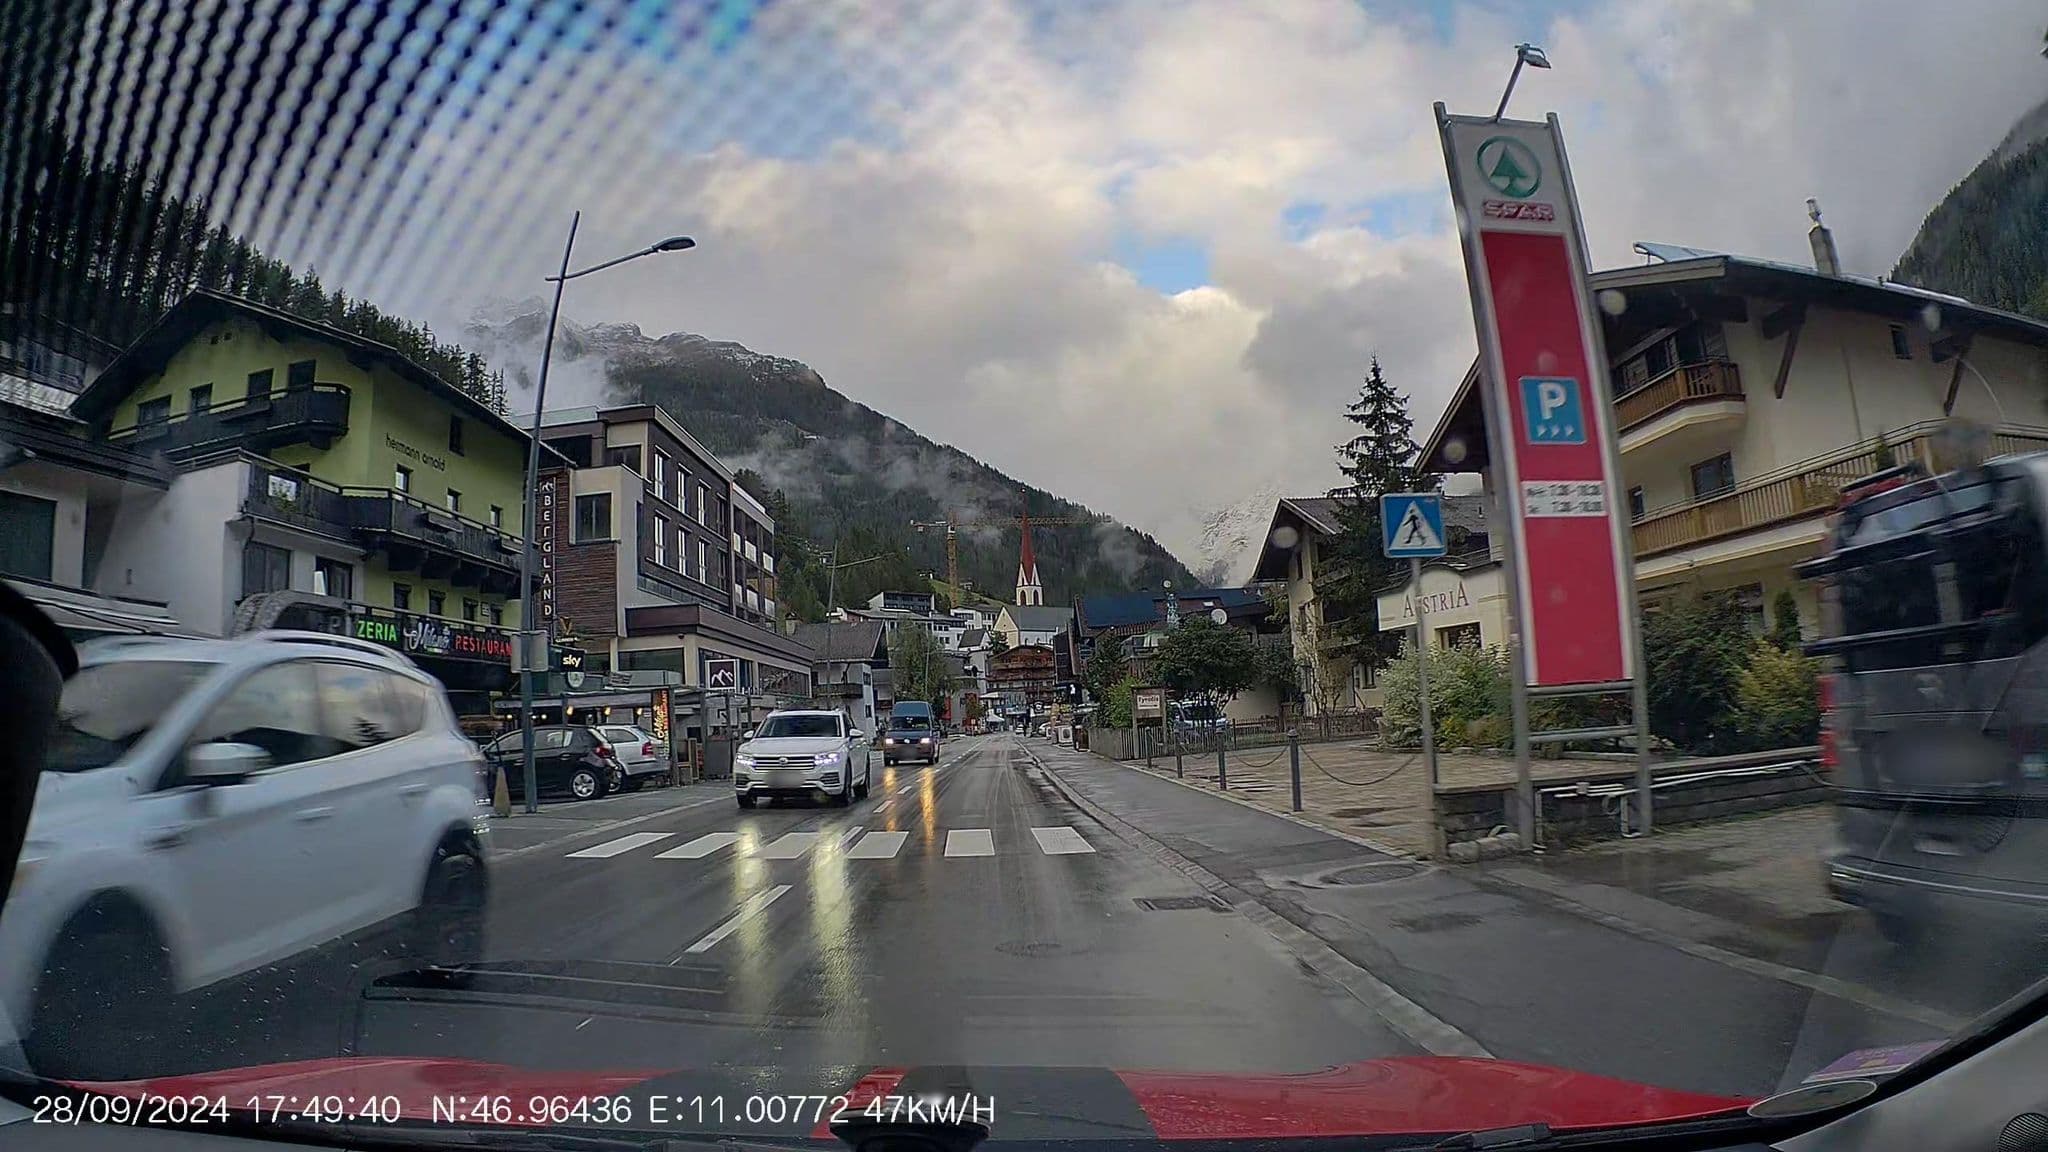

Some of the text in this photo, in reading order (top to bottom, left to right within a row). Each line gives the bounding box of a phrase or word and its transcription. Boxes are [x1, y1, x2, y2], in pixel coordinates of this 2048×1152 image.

[1483, 201, 1555, 221] SPAR
[1538, 382, 1567, 420] P
[1403, 580, 1469, 618] ASTRIA
[455, 635, 513, 657] RESTAURAN
[562, 655, 582, 668] sky
